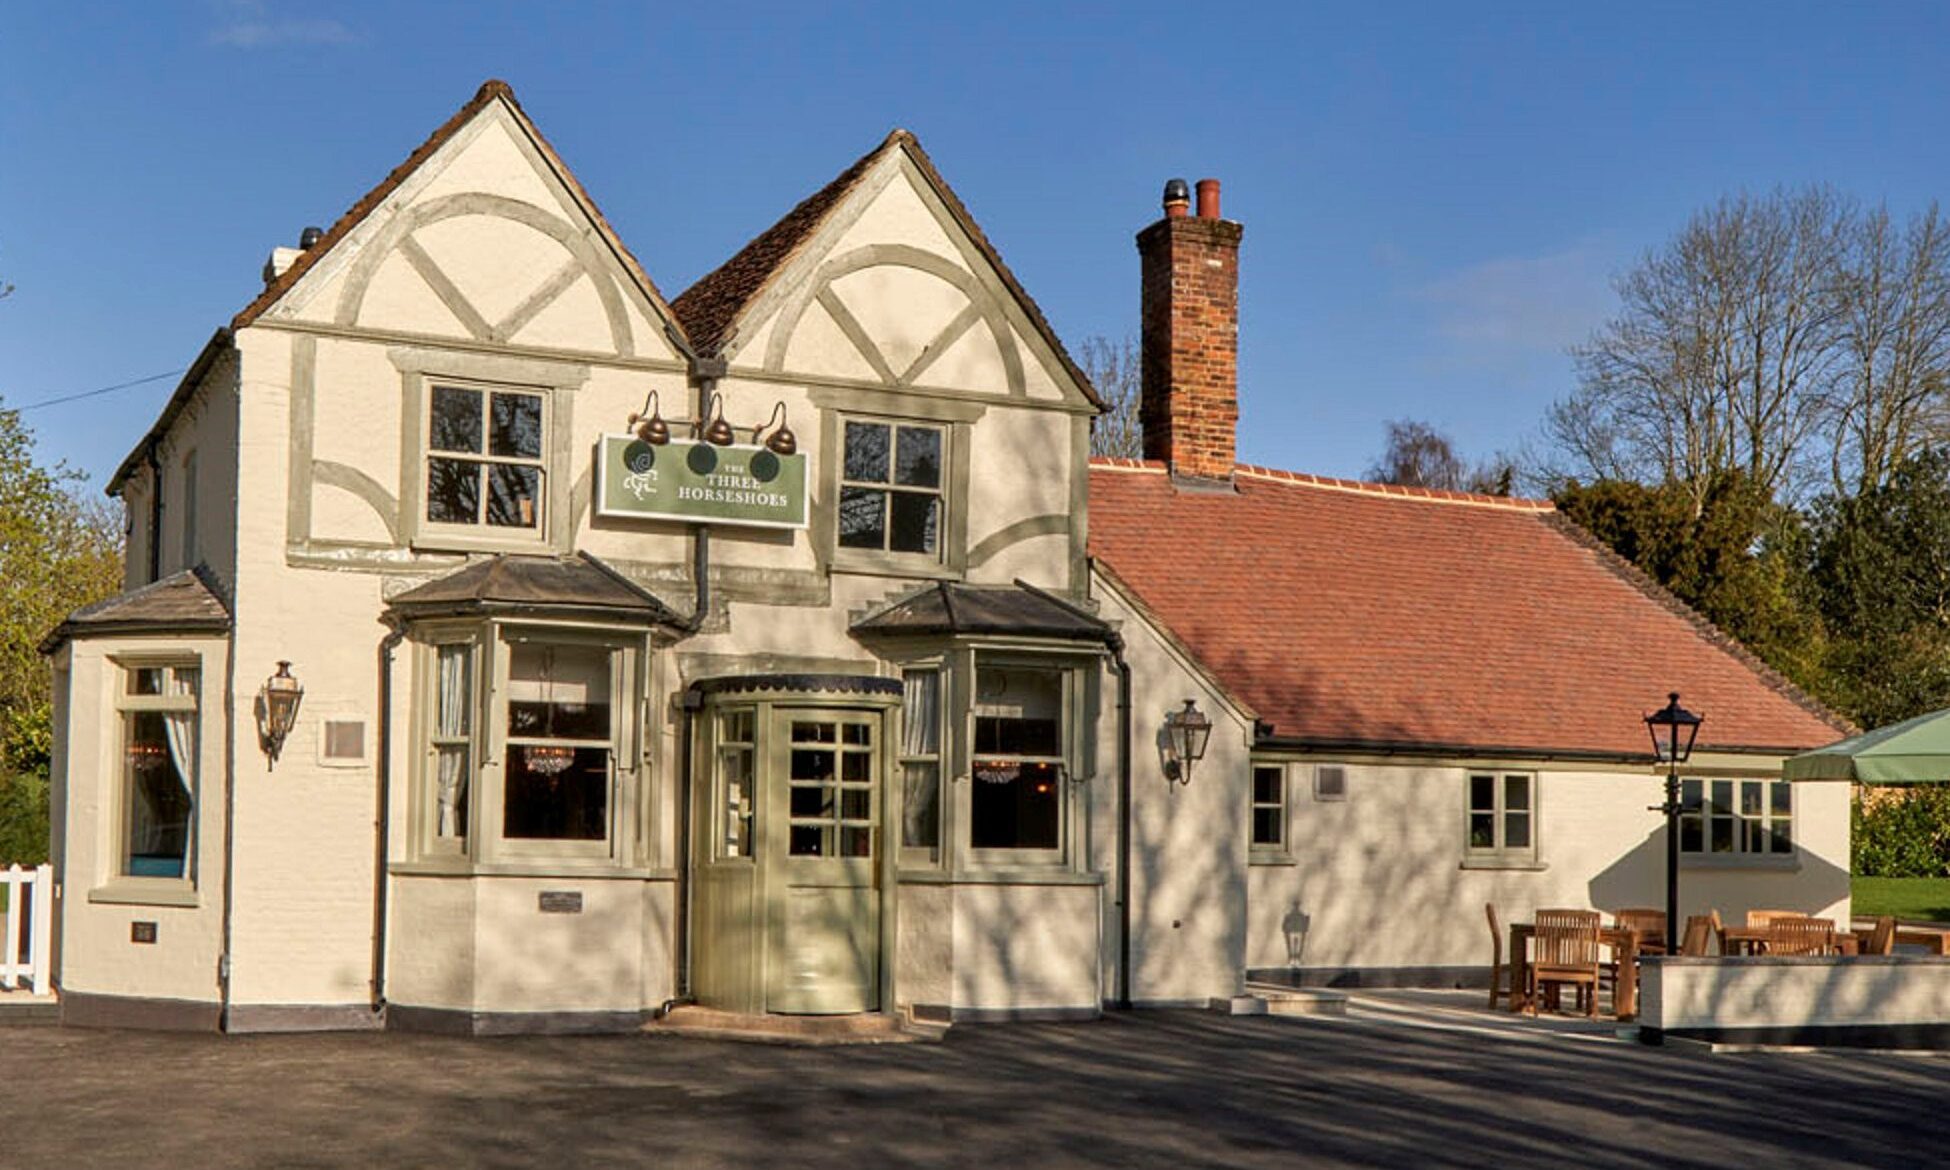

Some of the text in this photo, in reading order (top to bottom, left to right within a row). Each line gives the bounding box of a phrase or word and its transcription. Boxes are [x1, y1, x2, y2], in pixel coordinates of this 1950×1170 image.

[725, 464, 744, 474] THE
[706, 473, 761, 489] THREE
[679, 486, 788, 507] HORSESHOES
